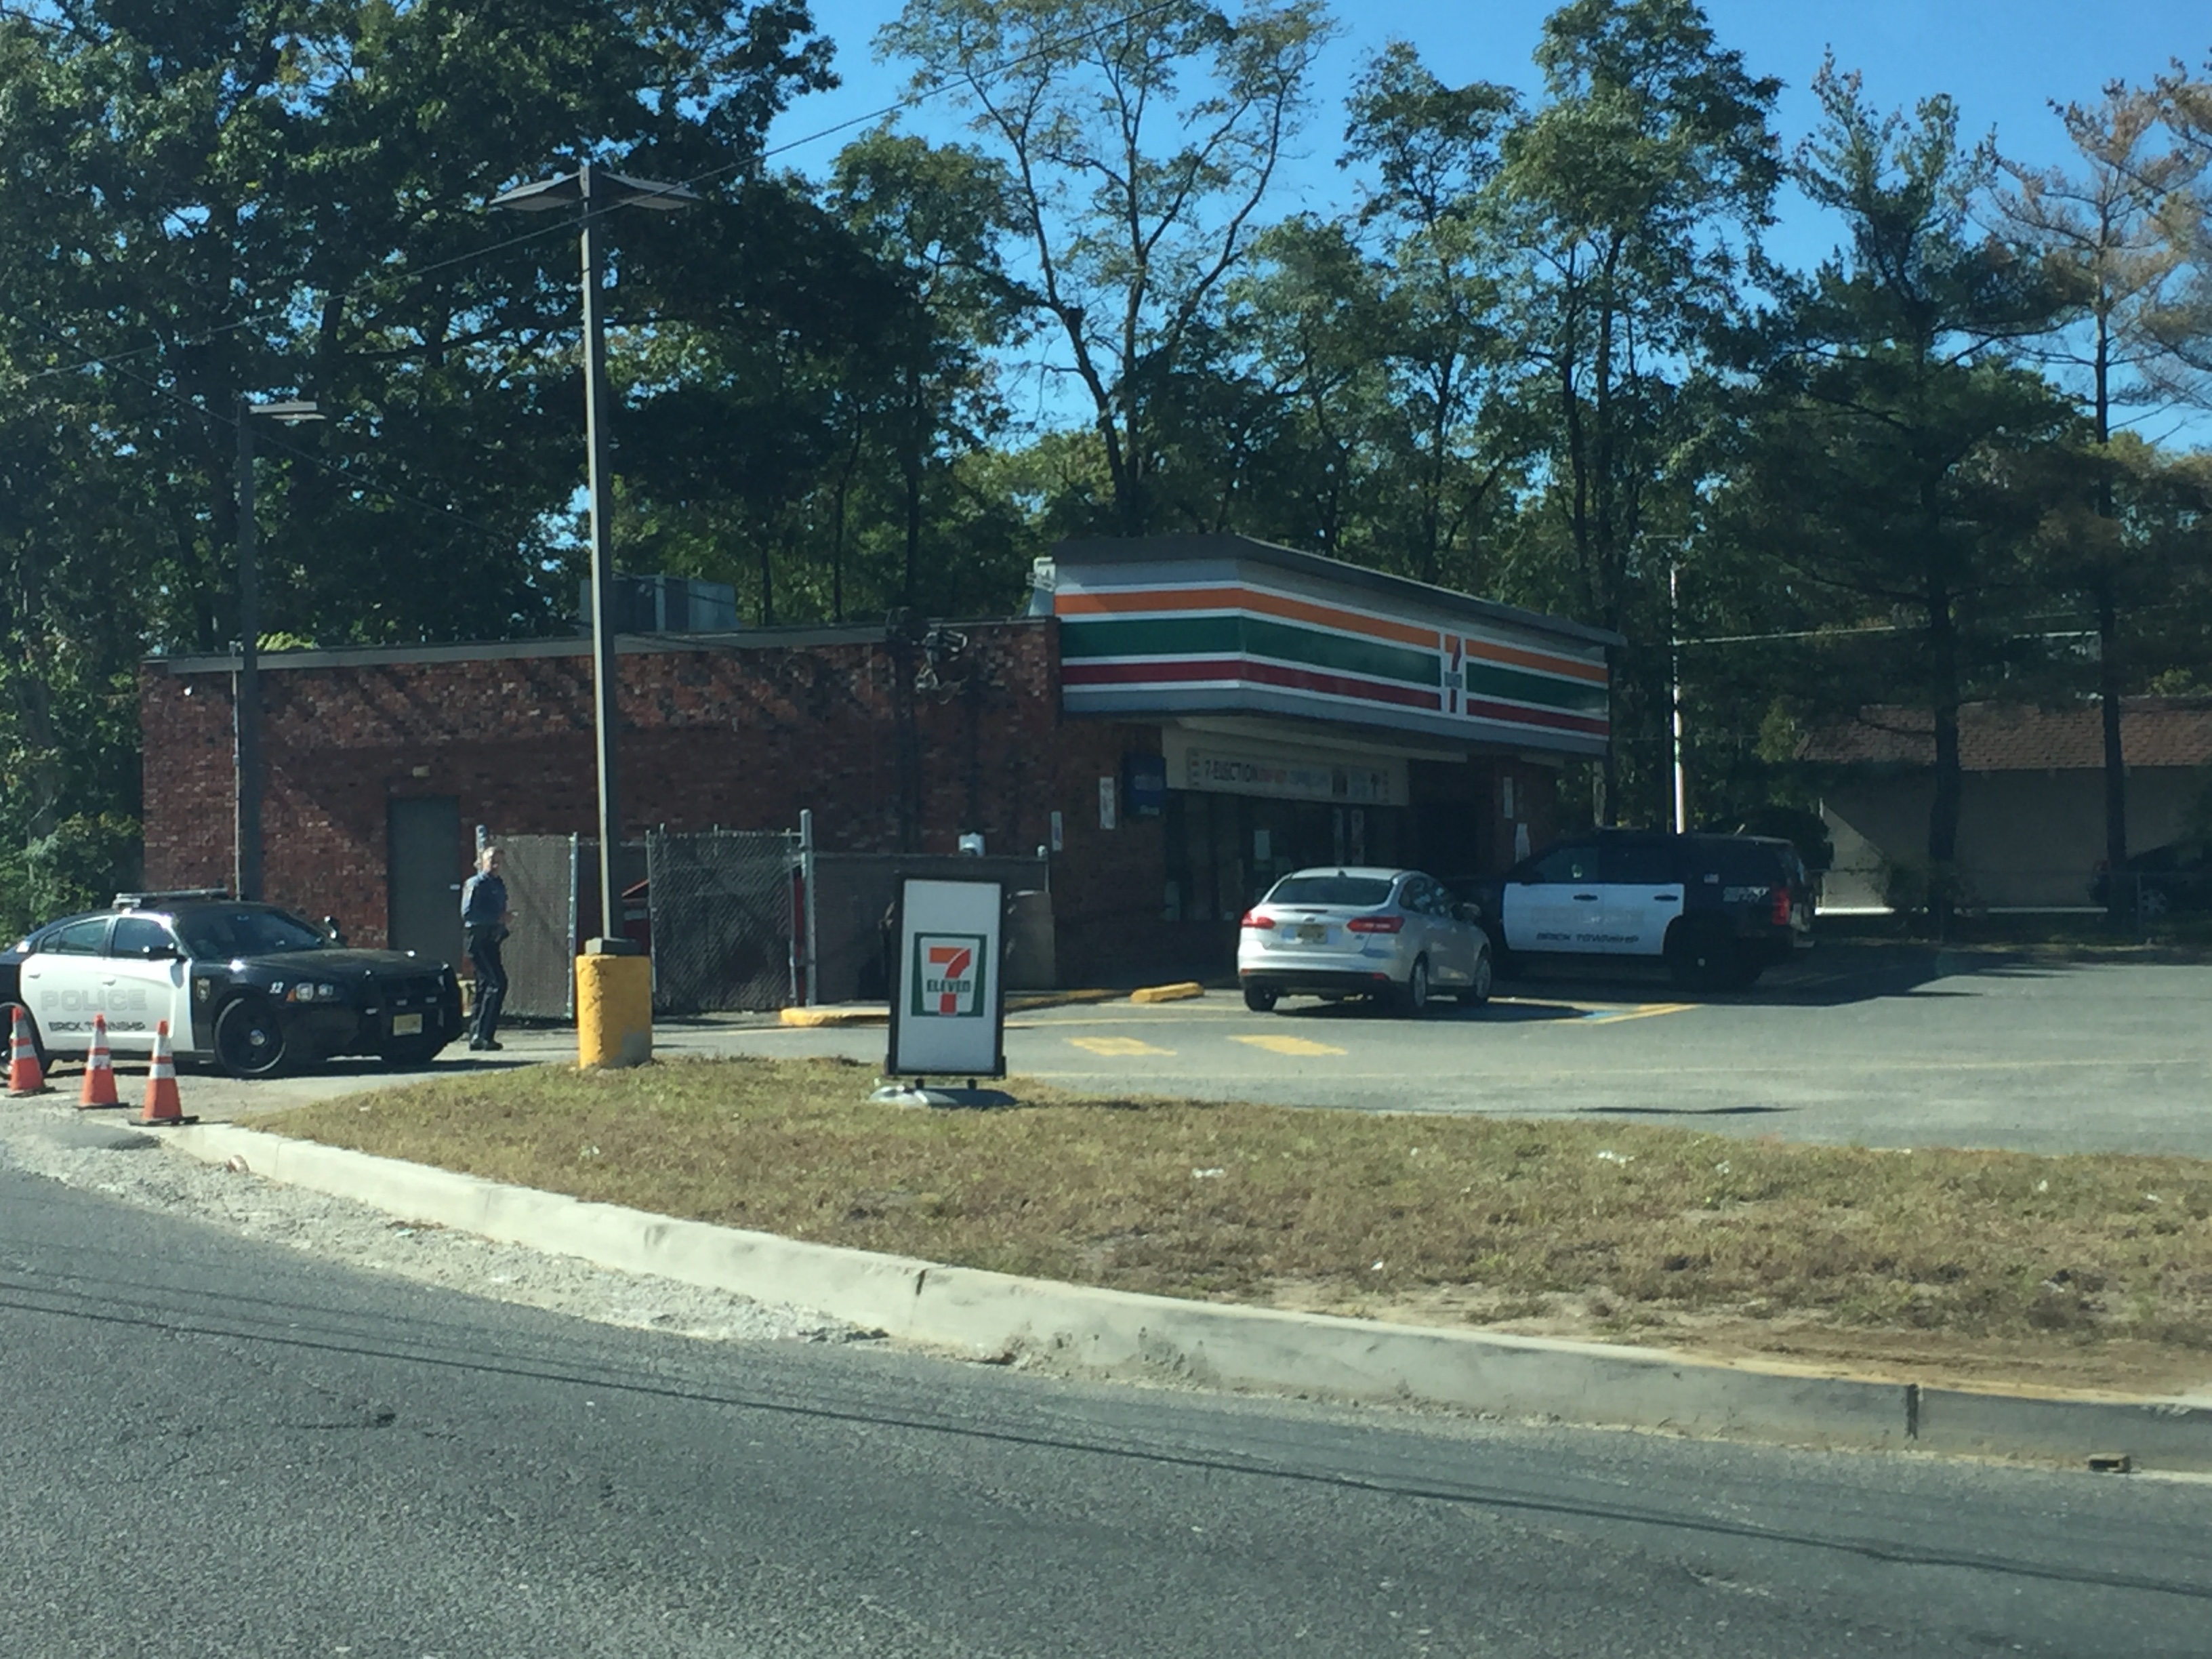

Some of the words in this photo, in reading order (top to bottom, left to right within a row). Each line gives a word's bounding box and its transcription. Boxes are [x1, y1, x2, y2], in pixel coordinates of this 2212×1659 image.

[1445, 634, 1462, 713] 7
[41, 989, 147, 1011] POLICE
[929, 947, 971, 1015] 7
[85, 1021, 145, 1031] TNSHIP
